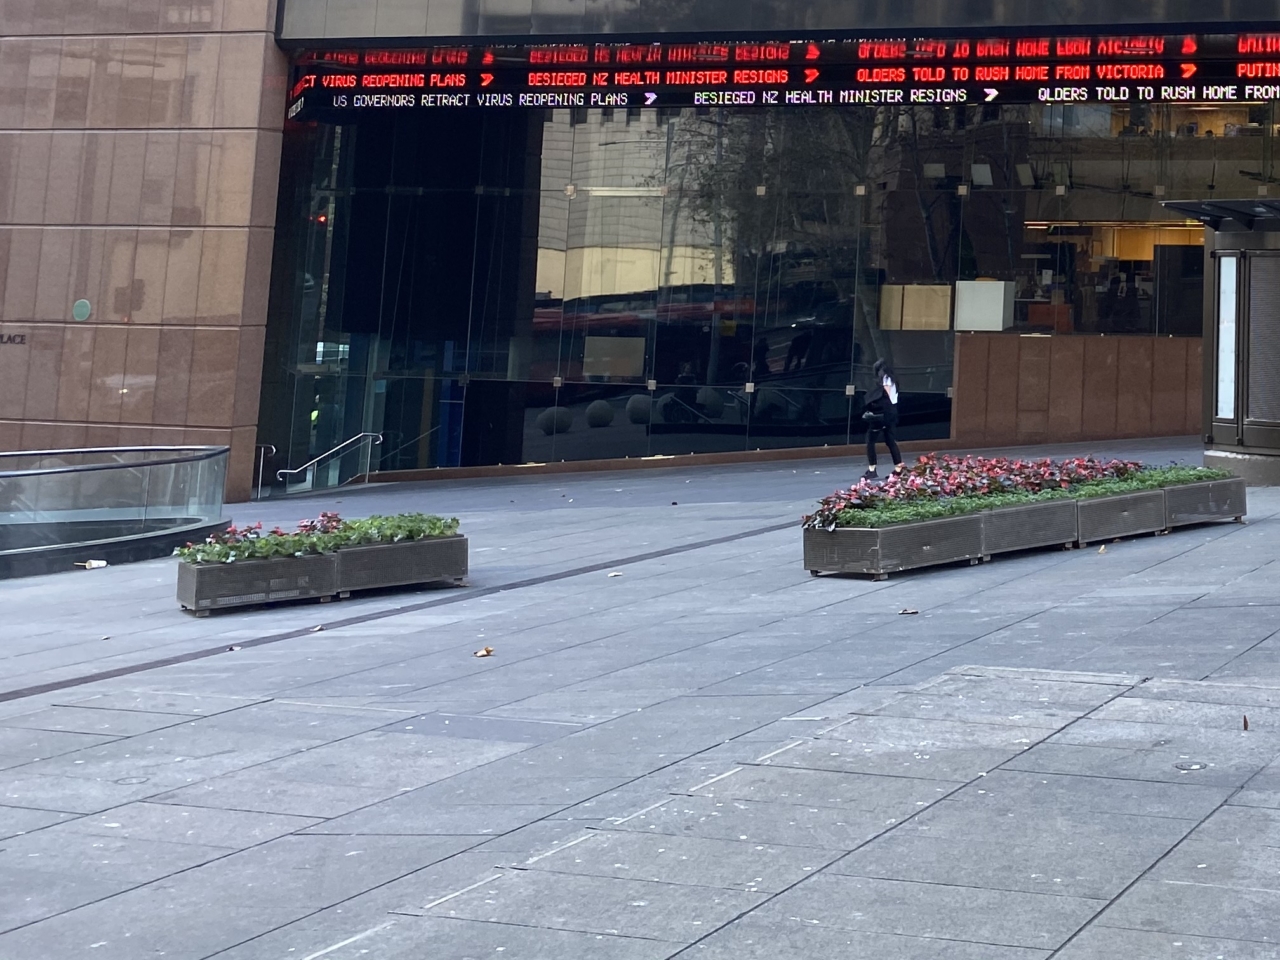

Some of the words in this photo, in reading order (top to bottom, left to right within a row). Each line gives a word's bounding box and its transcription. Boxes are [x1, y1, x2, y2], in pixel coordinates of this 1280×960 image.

[321, 74, 357, 87] VIRUS
[362, 74, 425, 87] REOPENING
[430, 73, 466, 87] PLANS
[528, 72, 587, 86] BESIEGED
[593, 72, 608, 85] NZ
[615, 71, 660, 85] HEALTH
[666, 70, 727, 84] MINISTER
[734, 70, 789, 83] RESIGNS
[912, 67, 946, 81] TOLD
[952, 67, 969, 81] TO
[975, 66, 1009, 80] RUSH
[1015, 66, 1050, 80] HOME
[1056, 65, 1090, 79] FROM
[1096, 64, 1165, 79] VICTORIA
[333, 94, 348, 107] US
[353, 94, 415, 107] GOVERNORS
[421, 93, 470, 107] RETRACT
[477, 93, 513, 106] VIRUS
[519, 92, 584, 106] REOPENING
[590, 92, 628, 106] PLANS
[694, 91, 756, 105] BESIEGED
[762, 91, 778, 104] NZ
[785, 90, 833, 104] HEALTH
[840, 89, 904, 103] MINISTER
[910, 88, 967, 102] RESIGNS
[1096, 87, 1129, 100] TOLD
[1137, 86, 1154, 100] TO
[1161, 86, 1196, 99] RUSH
[1203, 86, 1237, 99] HOME
[1245, 85, 1280, 99] FROM
[0, 334, 26, 345] LACE
